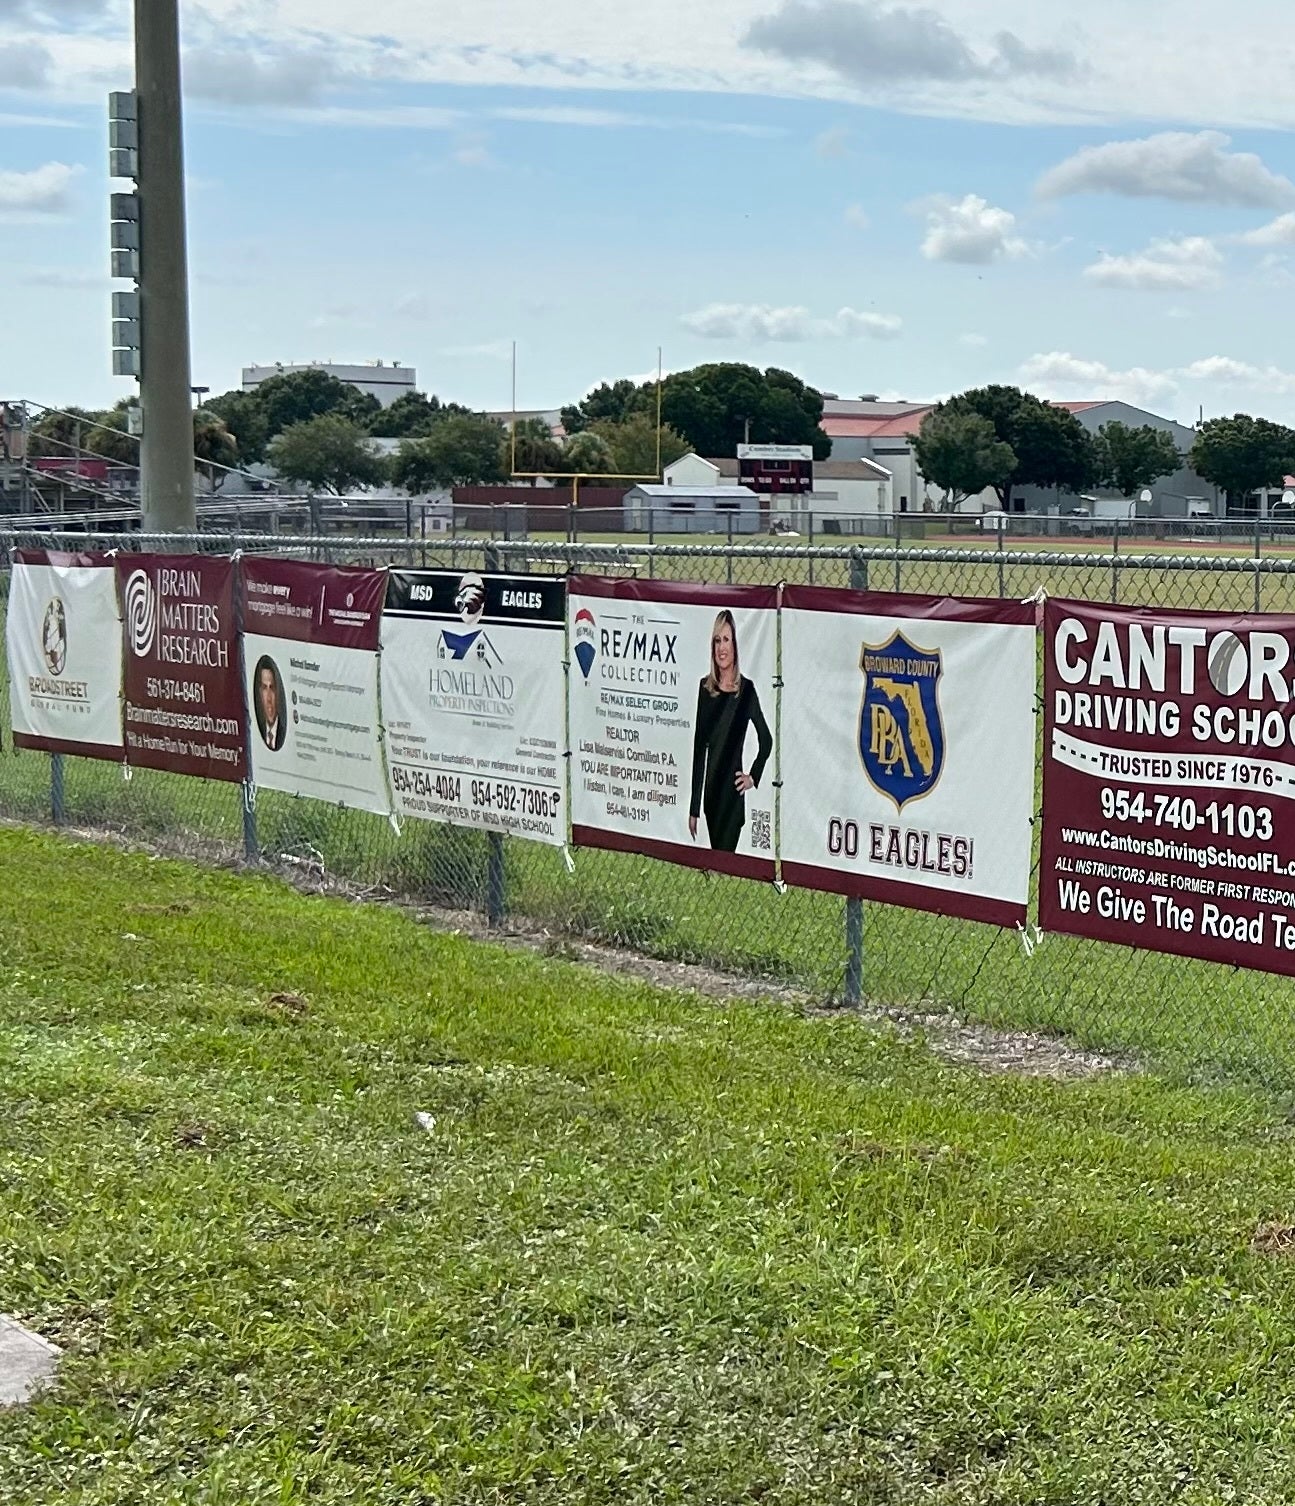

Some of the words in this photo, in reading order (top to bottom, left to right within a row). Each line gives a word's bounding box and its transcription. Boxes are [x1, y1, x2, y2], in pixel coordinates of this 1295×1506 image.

[161, 568, 201, 598] BRAIN
[410, 584, 434, 601] MSD
[501, 590, 542, 609] EAGLES
[162, 603, 220, 634] MATTERS
[632, 615, 645, 625] THE
[162, 635, 229, 668] RESEARCH
[600, 628, 678, 665] RE/MAX
[601, 664, 677, 686] COLLECTION
[864, 655, 906, 675] BROWARD
[907, 659, 940, 678] COUNTY
[29, 676, 88, 698] BROADSTREET
[147, 676, 206, 704] 561-374-8461
[429, 668, 514, 700] HOMELAND
[66, 704, 91, 714] FUND
[429, 694, 466, 710] PROPERTY
[467, 698, 515, 717] INSPECTIONS
[600, 692, 624, 706] RE/MAX
[625, 696, 651, 710] SELECT
[652, 700, 679, 713] GROUP
[1055, 690, 1181, 738] DRIVING
[126, 701, 239, 736] Brainmattersresearch.com
[633, 712, 654, 726] Luxury
[655, 714, 691, 729] Properties
[903, 688, 930, 760] FLORIDA
[143, 733, 165, 752] Home
[165, 736, 178, 753] Run
[178, 738, 188, 755] for
[188, 740, 207, 758] Your
[606, 726, 640, 744] REALTOR
[869, 703, 914, 778] PBA
[476, 759, 490, 769] your
[580, 739, 594, 754] Lisa
[661, 752, 678, 767] P.A.
[580, 760, 596, 774] YOU
[596, 762, 609, 776] ARE
[610, 765, 652, 784] IMPORTANT
[652, 772, 665, 786] TO
[665, 773, 679, 788] ME
[1099, 751, 1173, 779] TRUSTED
[1177, 760, 1226, 782] SINCE
[1231, 762, 1275, 788] 1976
[392, 766, 462, 803] 954-254-4084
[471, 779, 549, 817] 954-592-7306
[631, 789, 646, 801] am
[402, 796, 427, 812] PROUD
[427, 800, 469, 819] SUPPORTER
[470, 809, 481, 822] OF
[482, 812, 500, 825] MSD
[500, 815, 520, 829] HIGH
[522, 818, 555, 837] SCHOOL
[1101, 788, 1274, 841] 954-740-1103
[827, 816, 860, 858] GO
[869, 822, 975, 880] EAGLES!
[1055, 856, 1074, 873] ALL
[1075, 858, 1146, 884] INSTRUCTORS
[1146, 871, 1169, 888] ARE
[1170, 874, 1216, 896] FORMER
[1217, 882, 1251, 901] FIRST
[1058, 879, 1091, 914] We
[1097, 886, 1146, 924] Give
[1151, 895, 1195, 933] The
[1201, 904, 1264, 945] Road
